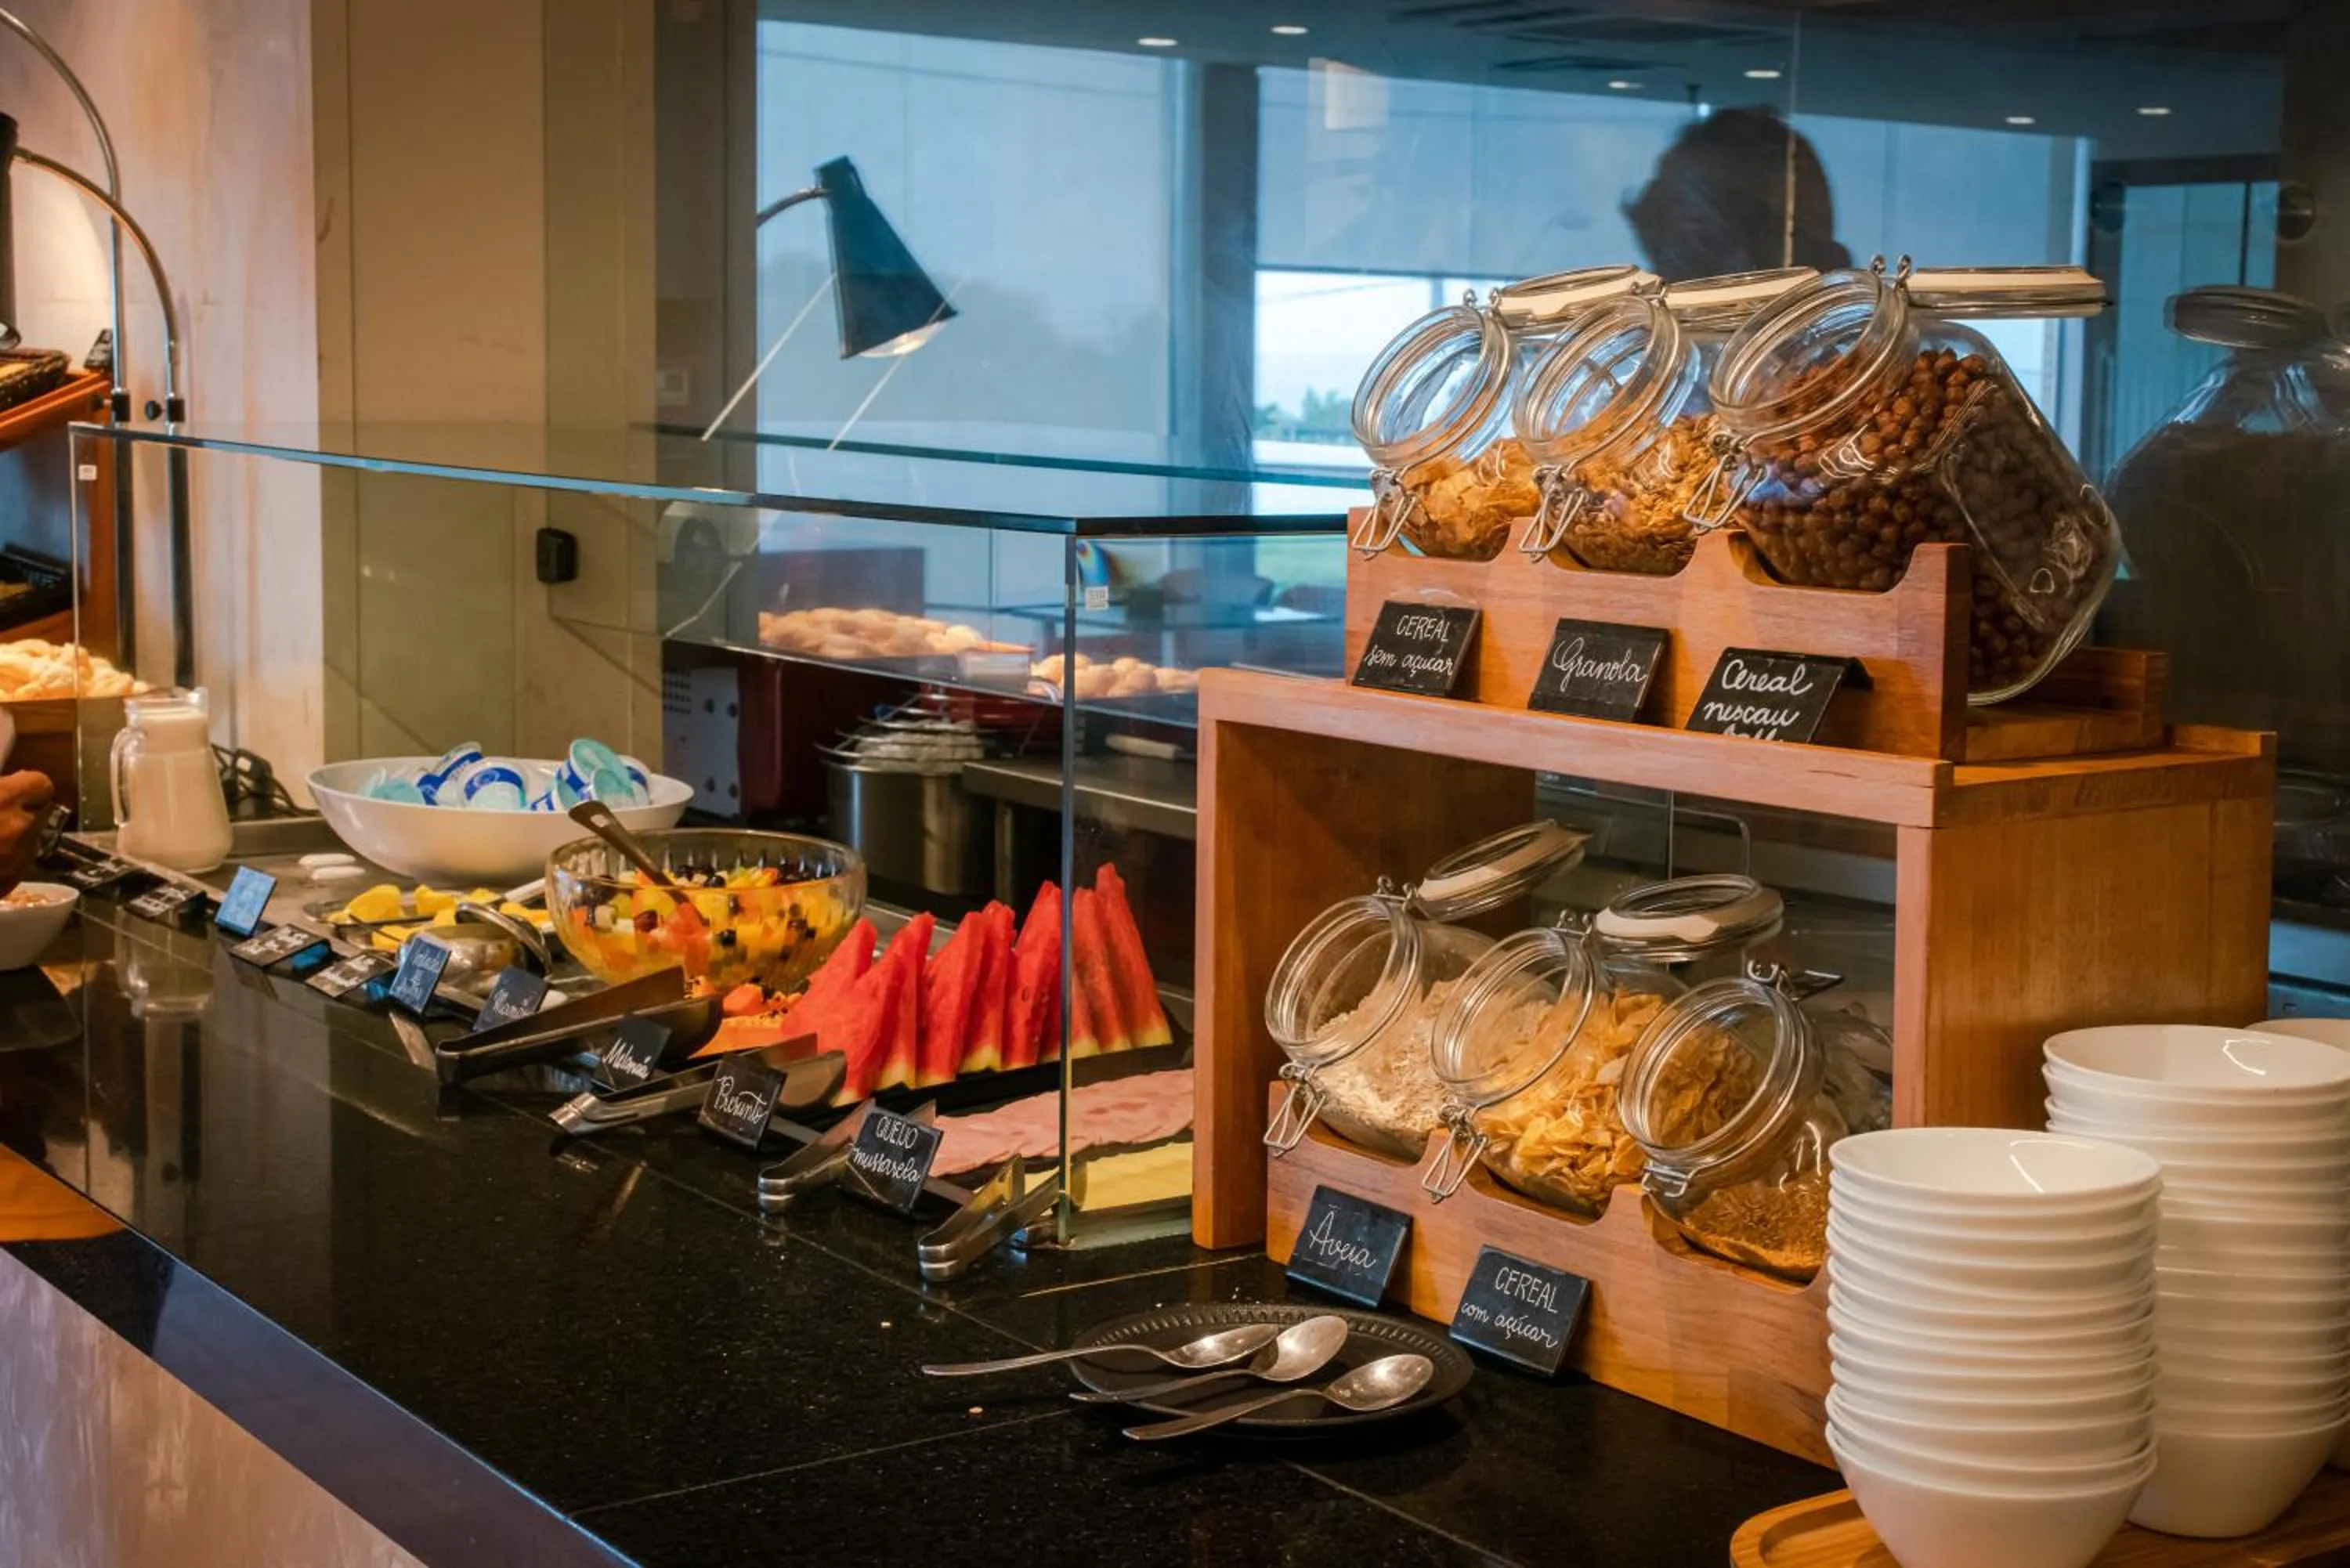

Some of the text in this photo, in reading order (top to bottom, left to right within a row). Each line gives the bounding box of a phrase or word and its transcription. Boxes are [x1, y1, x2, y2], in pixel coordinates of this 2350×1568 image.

[1396, 615, 1450, 642] CEREAL
[1552, 637, 1648, 692] Granola
[1721, 659, 1813, 695] Cereal
[1309, 1210, 1376, 1269] Aveia
[1495, 1266, 1559, 1314] CEREAL
[1460, 1302, 1489, 1323] com
